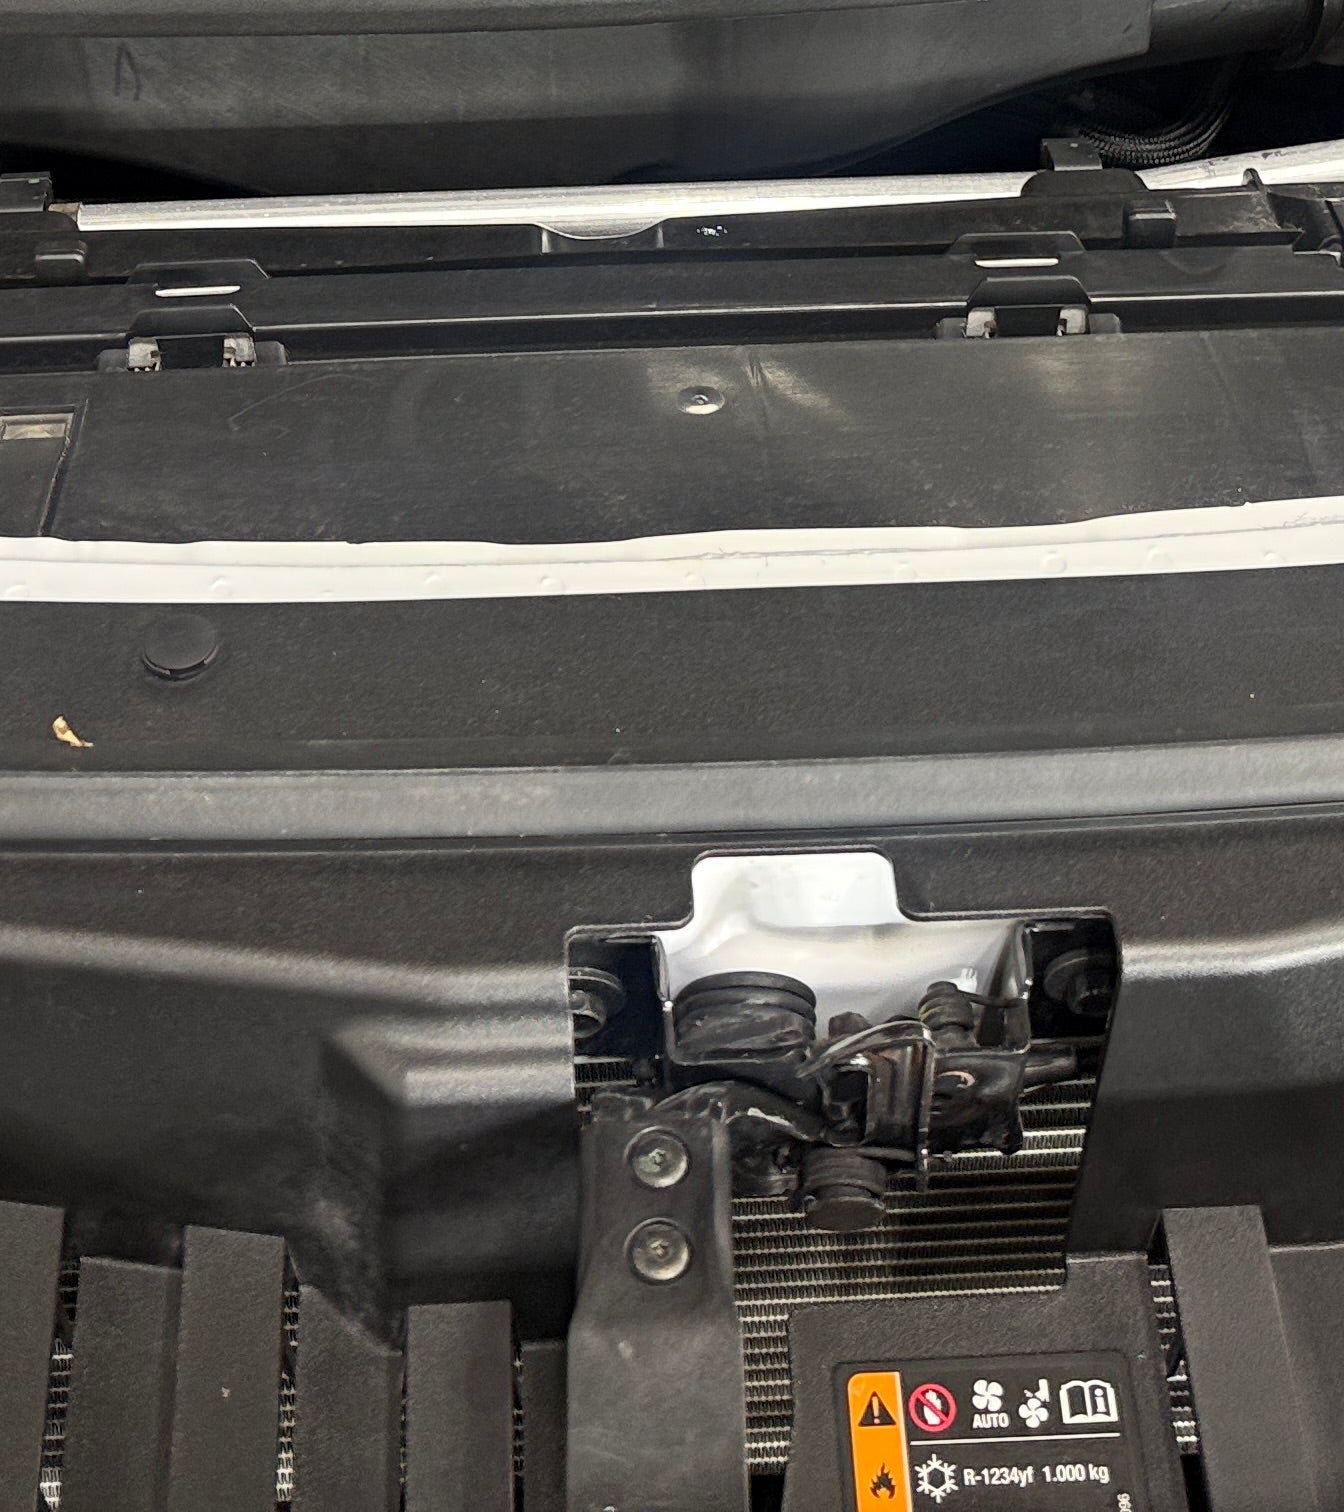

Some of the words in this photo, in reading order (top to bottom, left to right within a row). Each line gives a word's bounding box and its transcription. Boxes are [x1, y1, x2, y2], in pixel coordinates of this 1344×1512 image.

[972, 1412, 1010, 1429] AUTO
[963, 1466, 1035, 1489] R-1234yf
[1042, 1465, 1087, 1484] 1.000
[1088, 1463, 1111, 1485] kg
